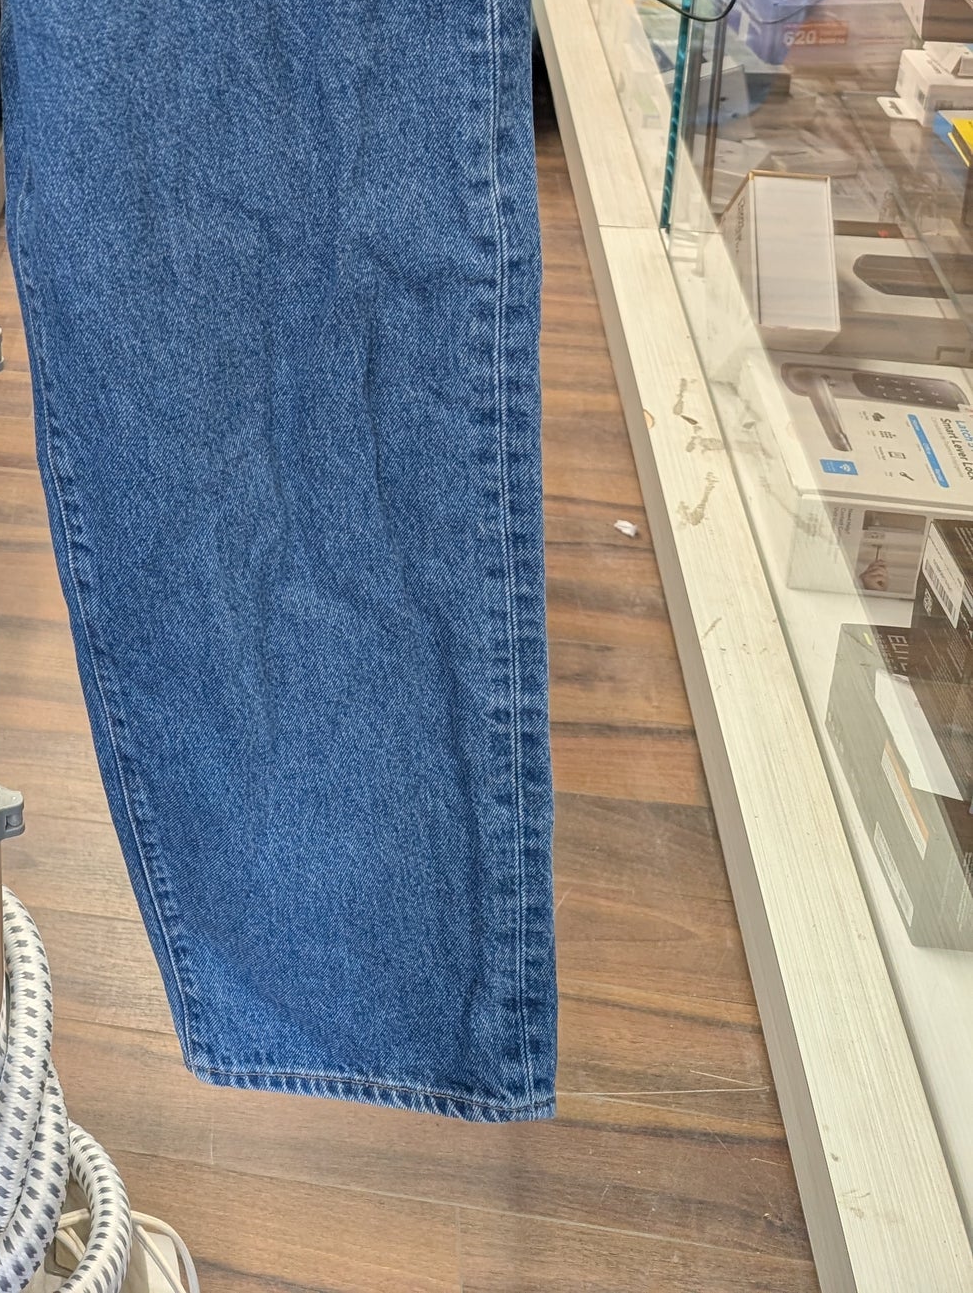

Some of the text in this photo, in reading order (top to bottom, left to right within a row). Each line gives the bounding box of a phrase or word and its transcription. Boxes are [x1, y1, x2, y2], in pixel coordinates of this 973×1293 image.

[783, 30, 817, 46] 620
[940, 417, 959, 439] Smart
[952, 439, 968, 461] Lever
